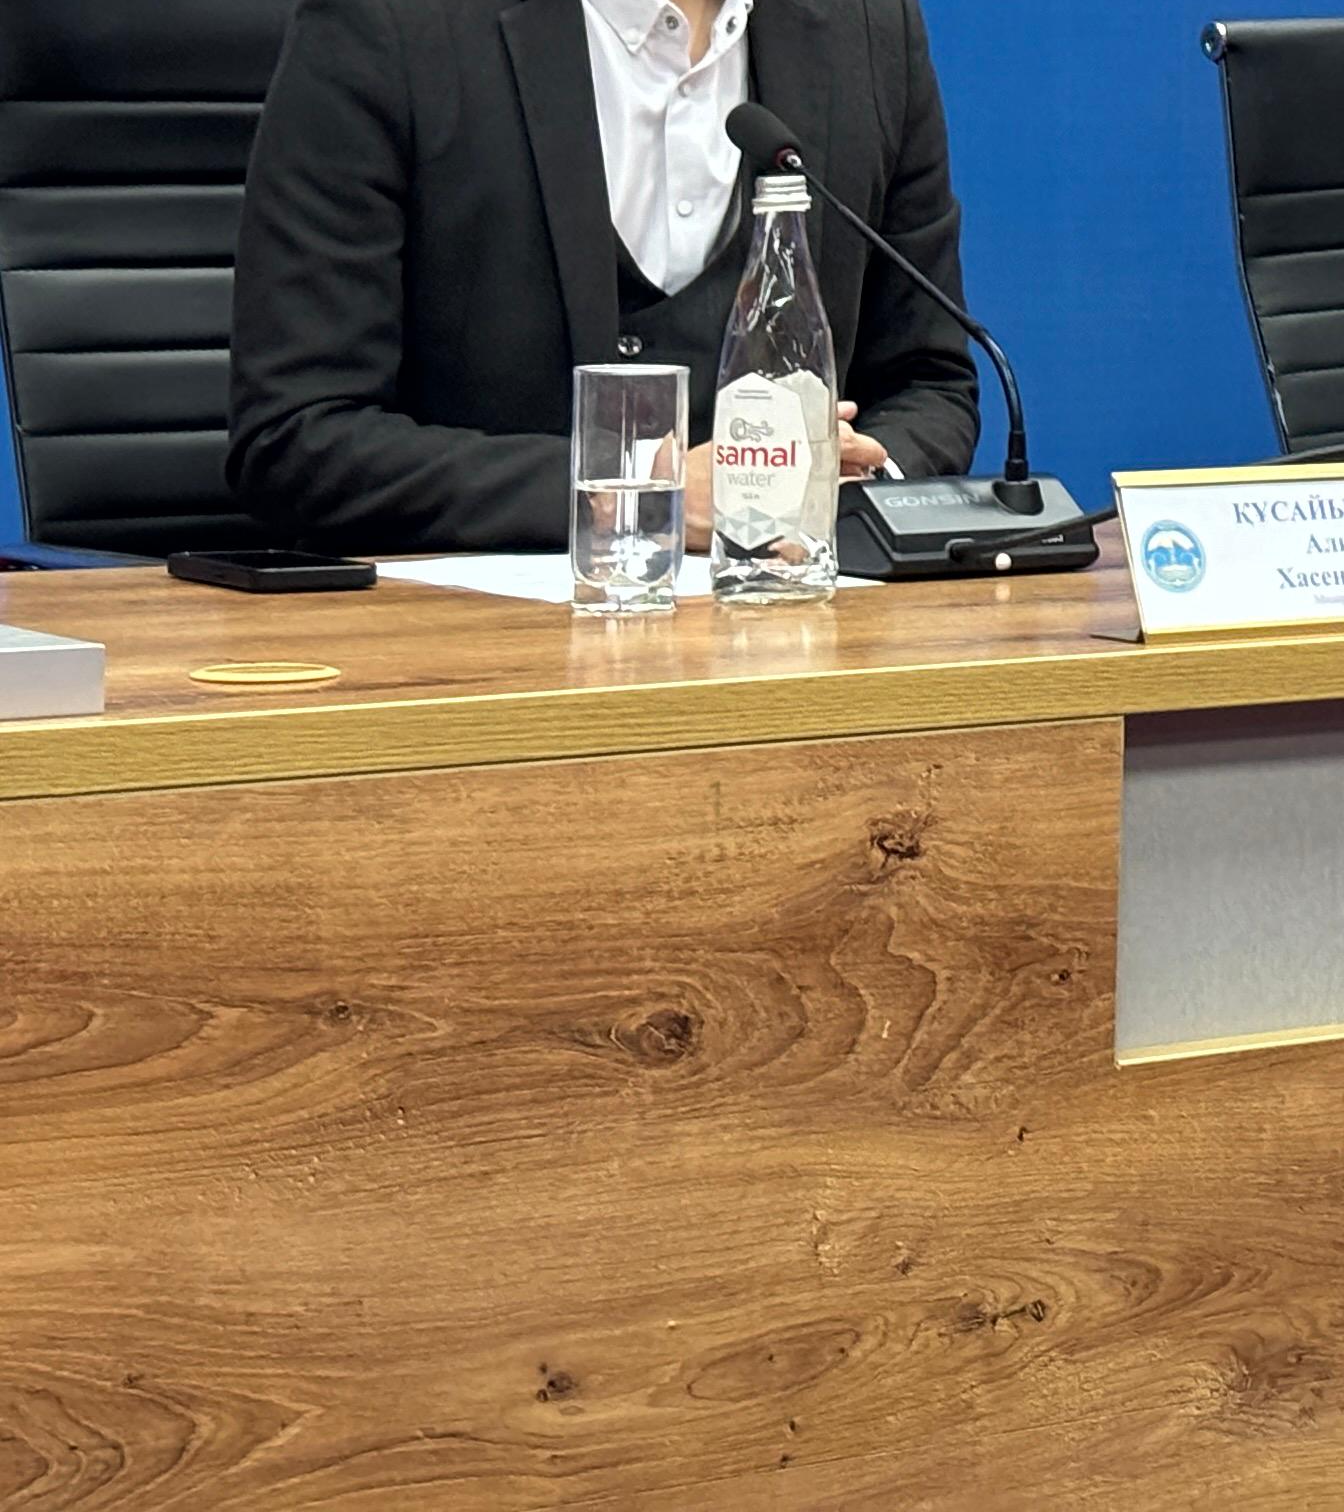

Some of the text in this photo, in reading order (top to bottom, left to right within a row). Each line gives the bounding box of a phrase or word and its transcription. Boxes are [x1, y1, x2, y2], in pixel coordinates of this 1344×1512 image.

[716, 440, 796, 467] samal
[727, 471, 776, 487] water
[884, 492, 981, 508] GONSIN
